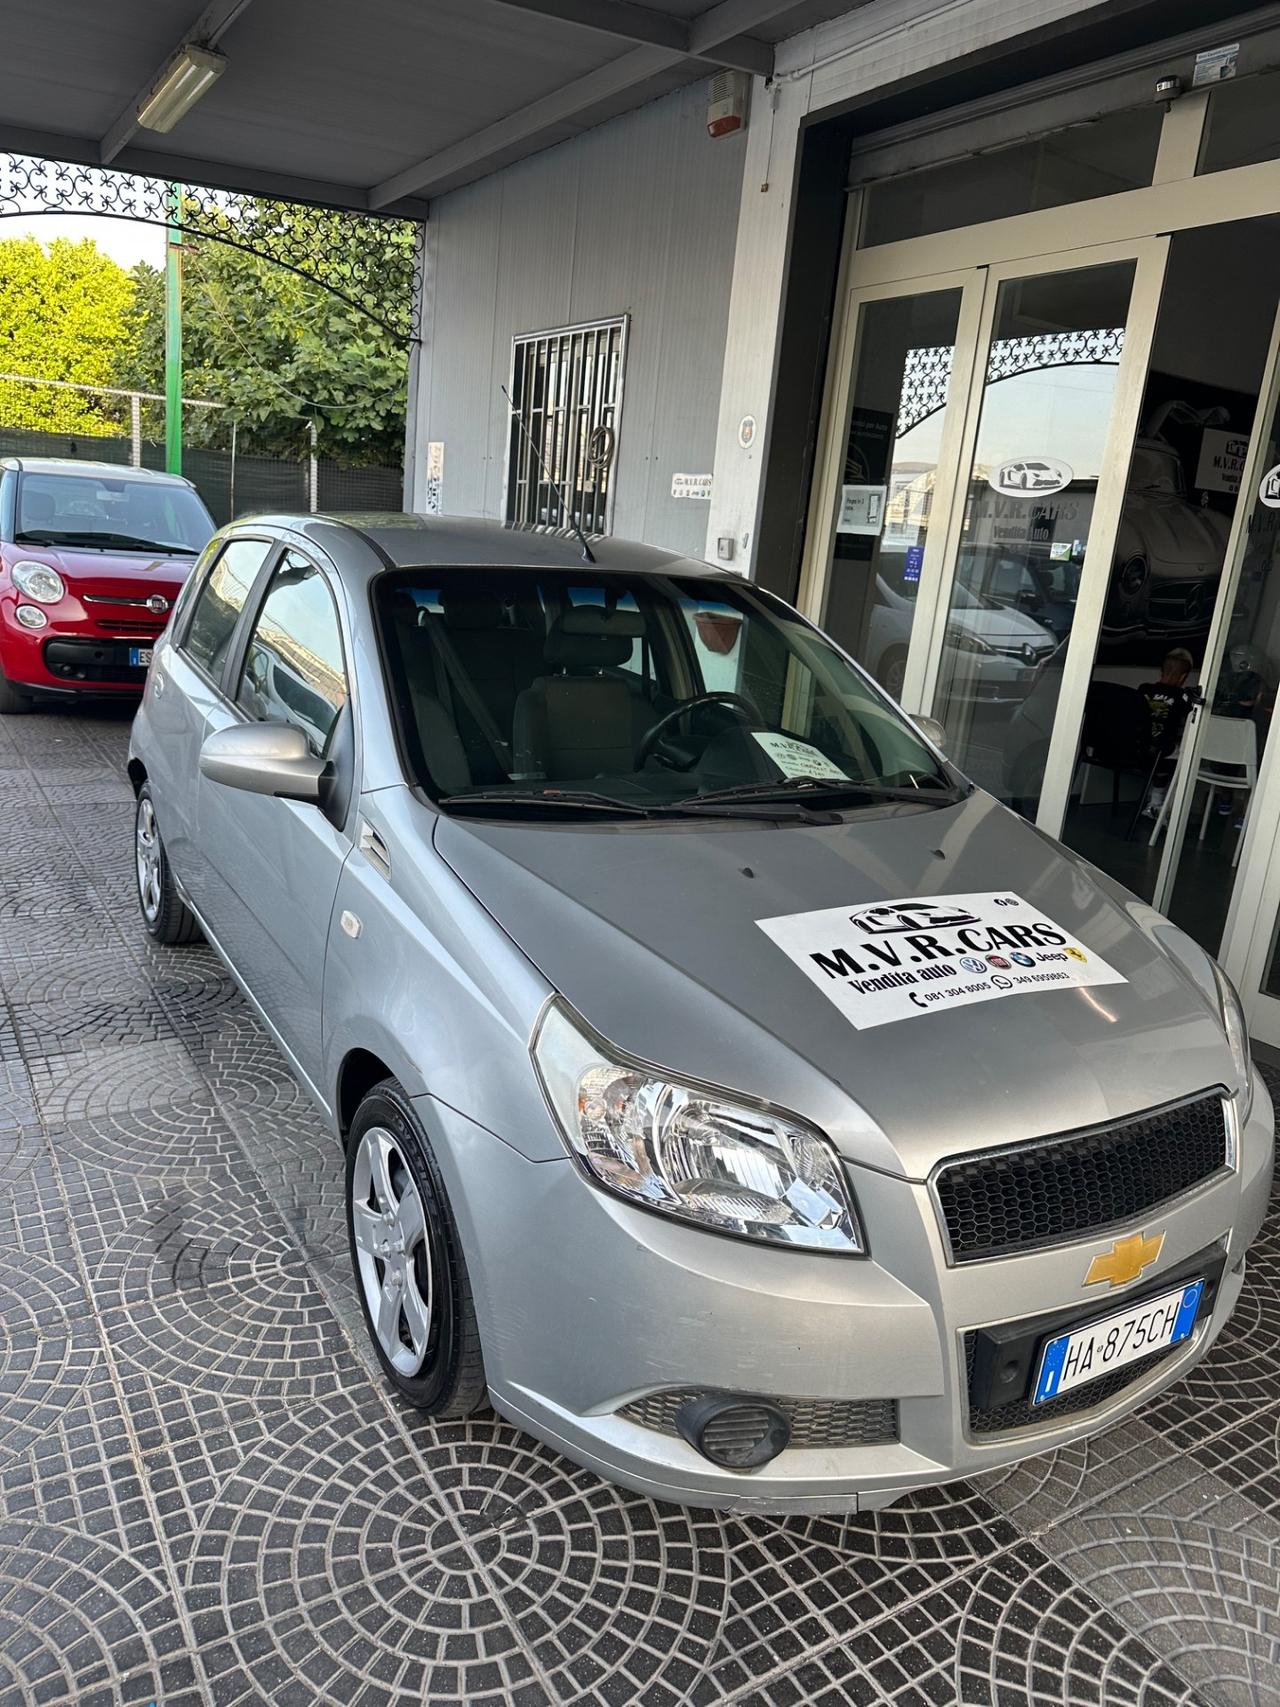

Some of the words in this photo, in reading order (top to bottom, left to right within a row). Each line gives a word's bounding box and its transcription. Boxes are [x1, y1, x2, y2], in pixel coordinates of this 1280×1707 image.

[809, 922, 1067, 979] M.V.R.CARS
[1035, 952, 1069, 963] Jeep
[848, 970, 917, 995] Vendita
[917, 964, 957, 981] auto
[1013, 975, 1033, 984] 349
[924, 991, 946, 1002] 081
[945, 987, 966, 997] 304
[965, 982, 992, 993] 8005
